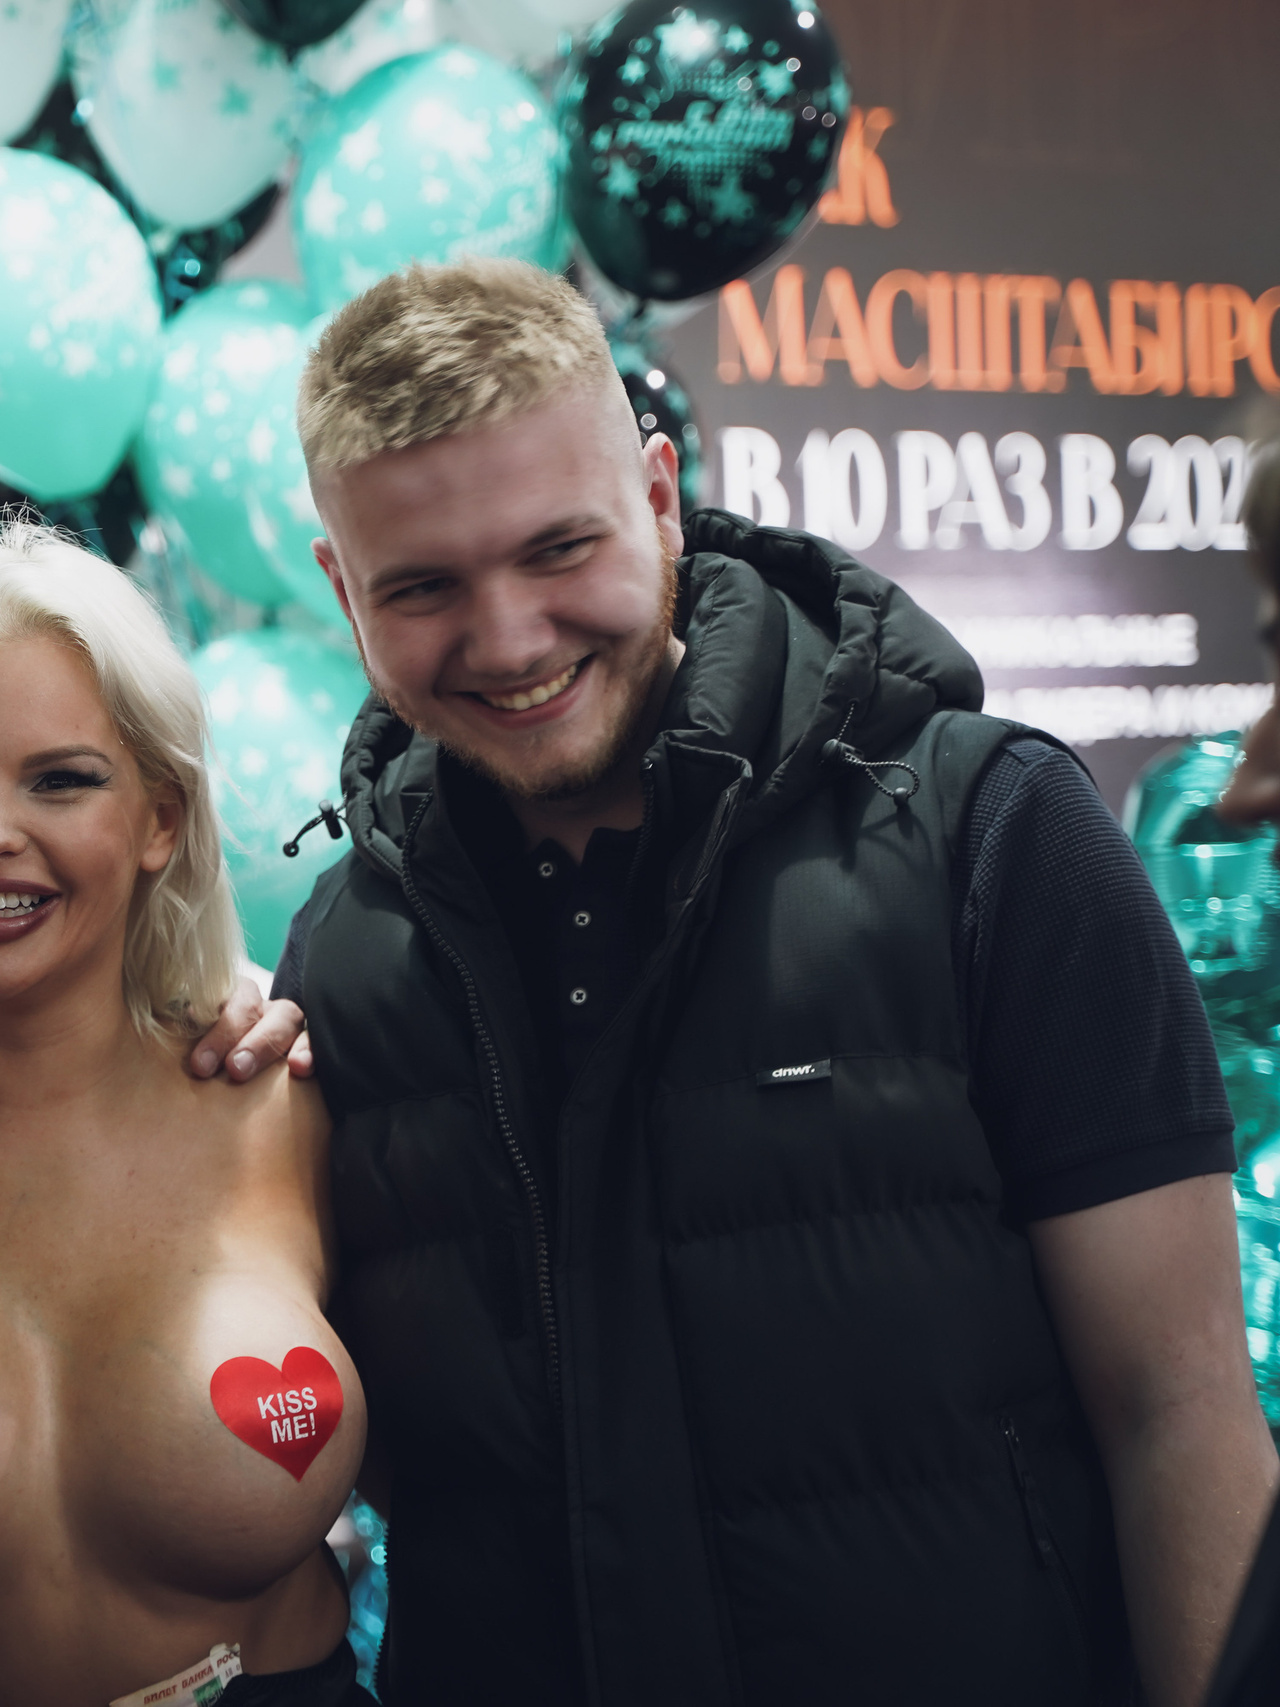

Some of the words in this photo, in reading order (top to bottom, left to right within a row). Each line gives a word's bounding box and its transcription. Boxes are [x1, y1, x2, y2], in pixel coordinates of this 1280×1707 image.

[795, 427, 888, 551] 10
[894, 430, 1052, 551] РАЗ
[1058, 432, 1124, 551] В
[1126, 433, 1252, 552] 202
[257, 1387, 317, 1419] KISS
[271, 1412, 316, 1443] ME!
